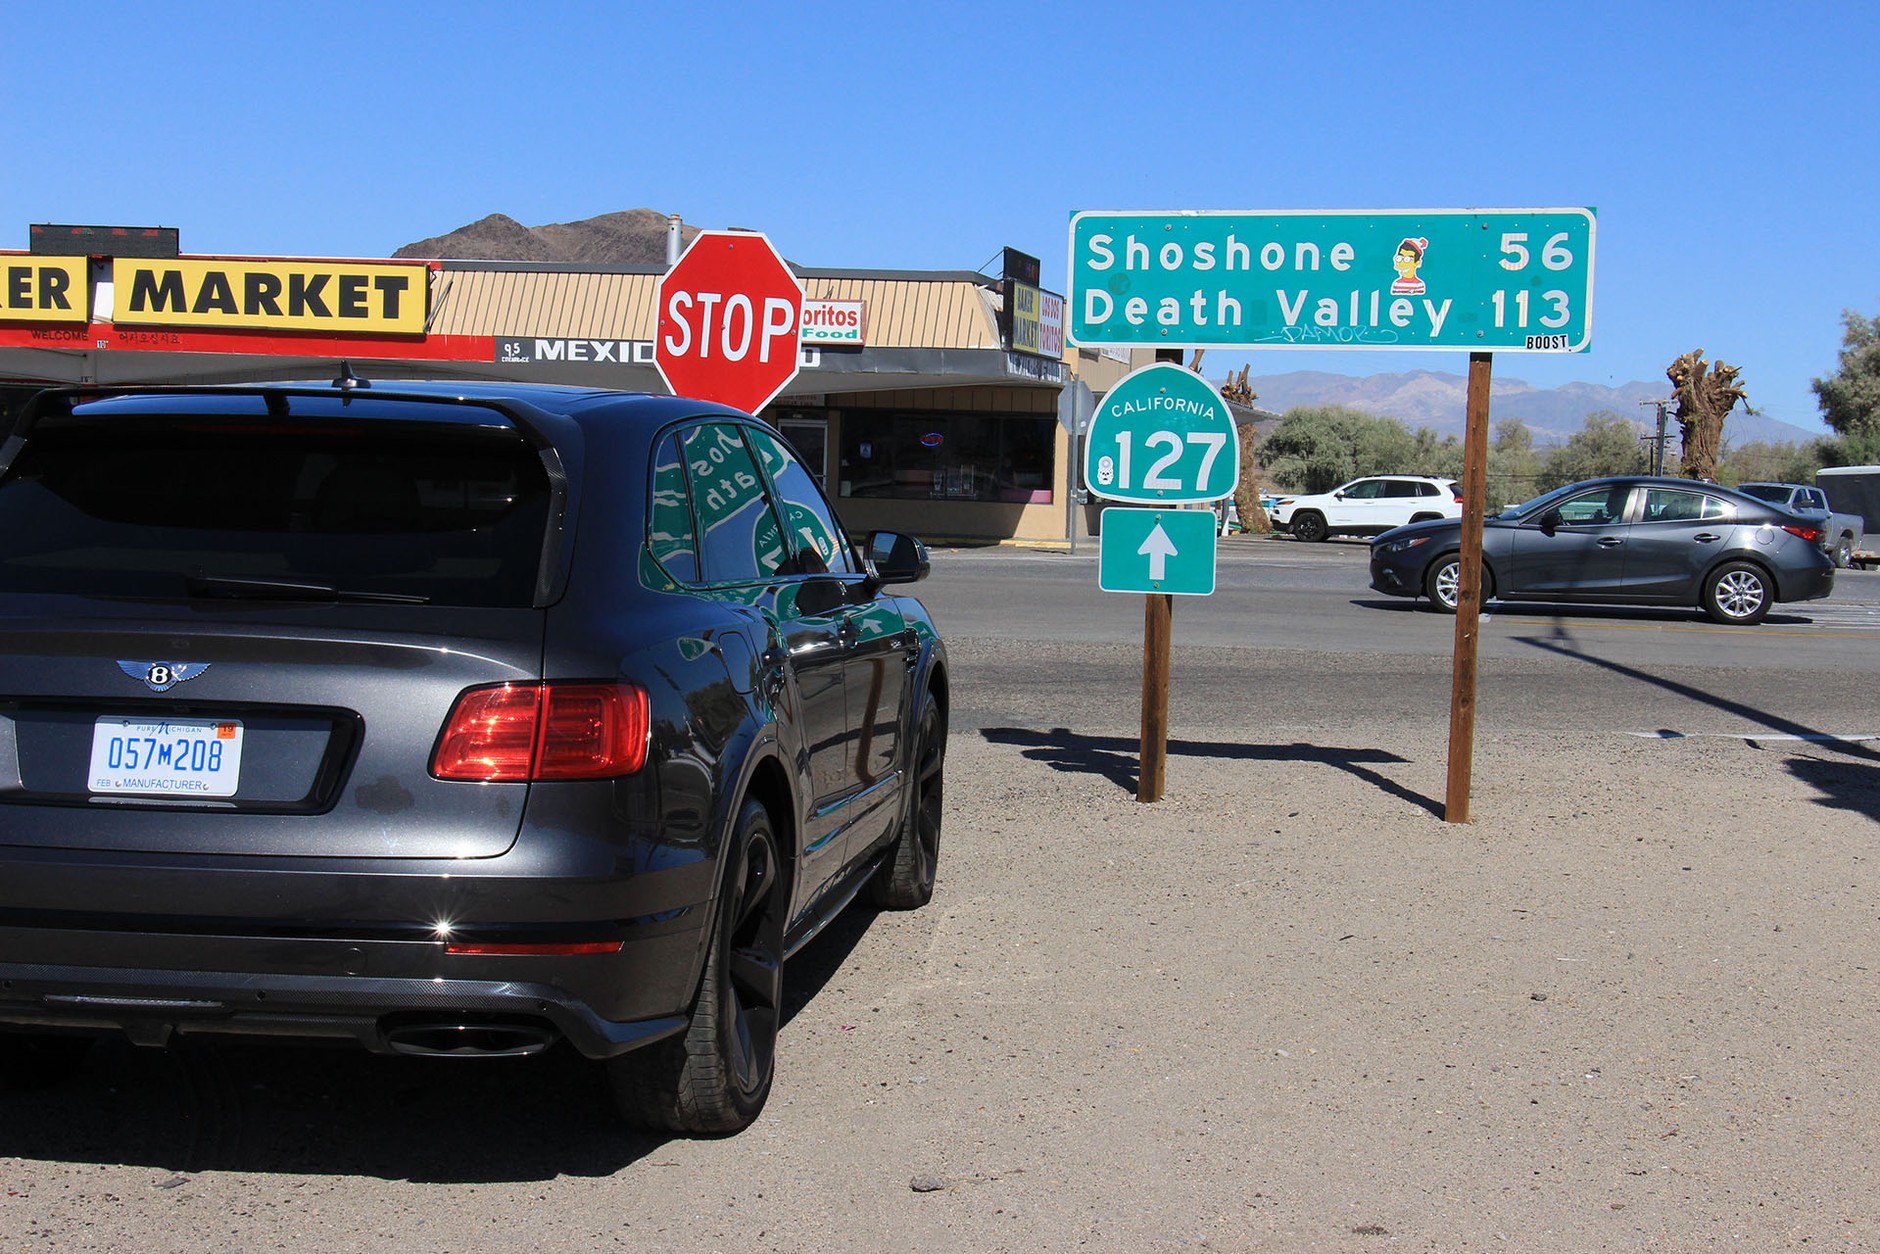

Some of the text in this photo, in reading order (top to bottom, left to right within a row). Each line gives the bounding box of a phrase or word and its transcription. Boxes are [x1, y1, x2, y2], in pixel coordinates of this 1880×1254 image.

[1087, 232, 1574, 271] Shoshone 56
[0, 266, 72, 310] ER
[129, 269, 409, 319] MARKET
[665, 290, 794, 363] STOP
[1085, 288, 1570, 338] Death Valley 113
[31, 329, 89, 341] WELCOME
[802, 328, 858, 339] Food
[1526, 335, 1567, 349] BOOST
[1112, 396, 1215, 421] CALIFORNIA
[1115, 430, 1227, 491] 127
[155, 666, 169, 684] B
[108, 737, 223, 772] 057M208
[96, 778, 202, 791] FEB MANUFACTURER
